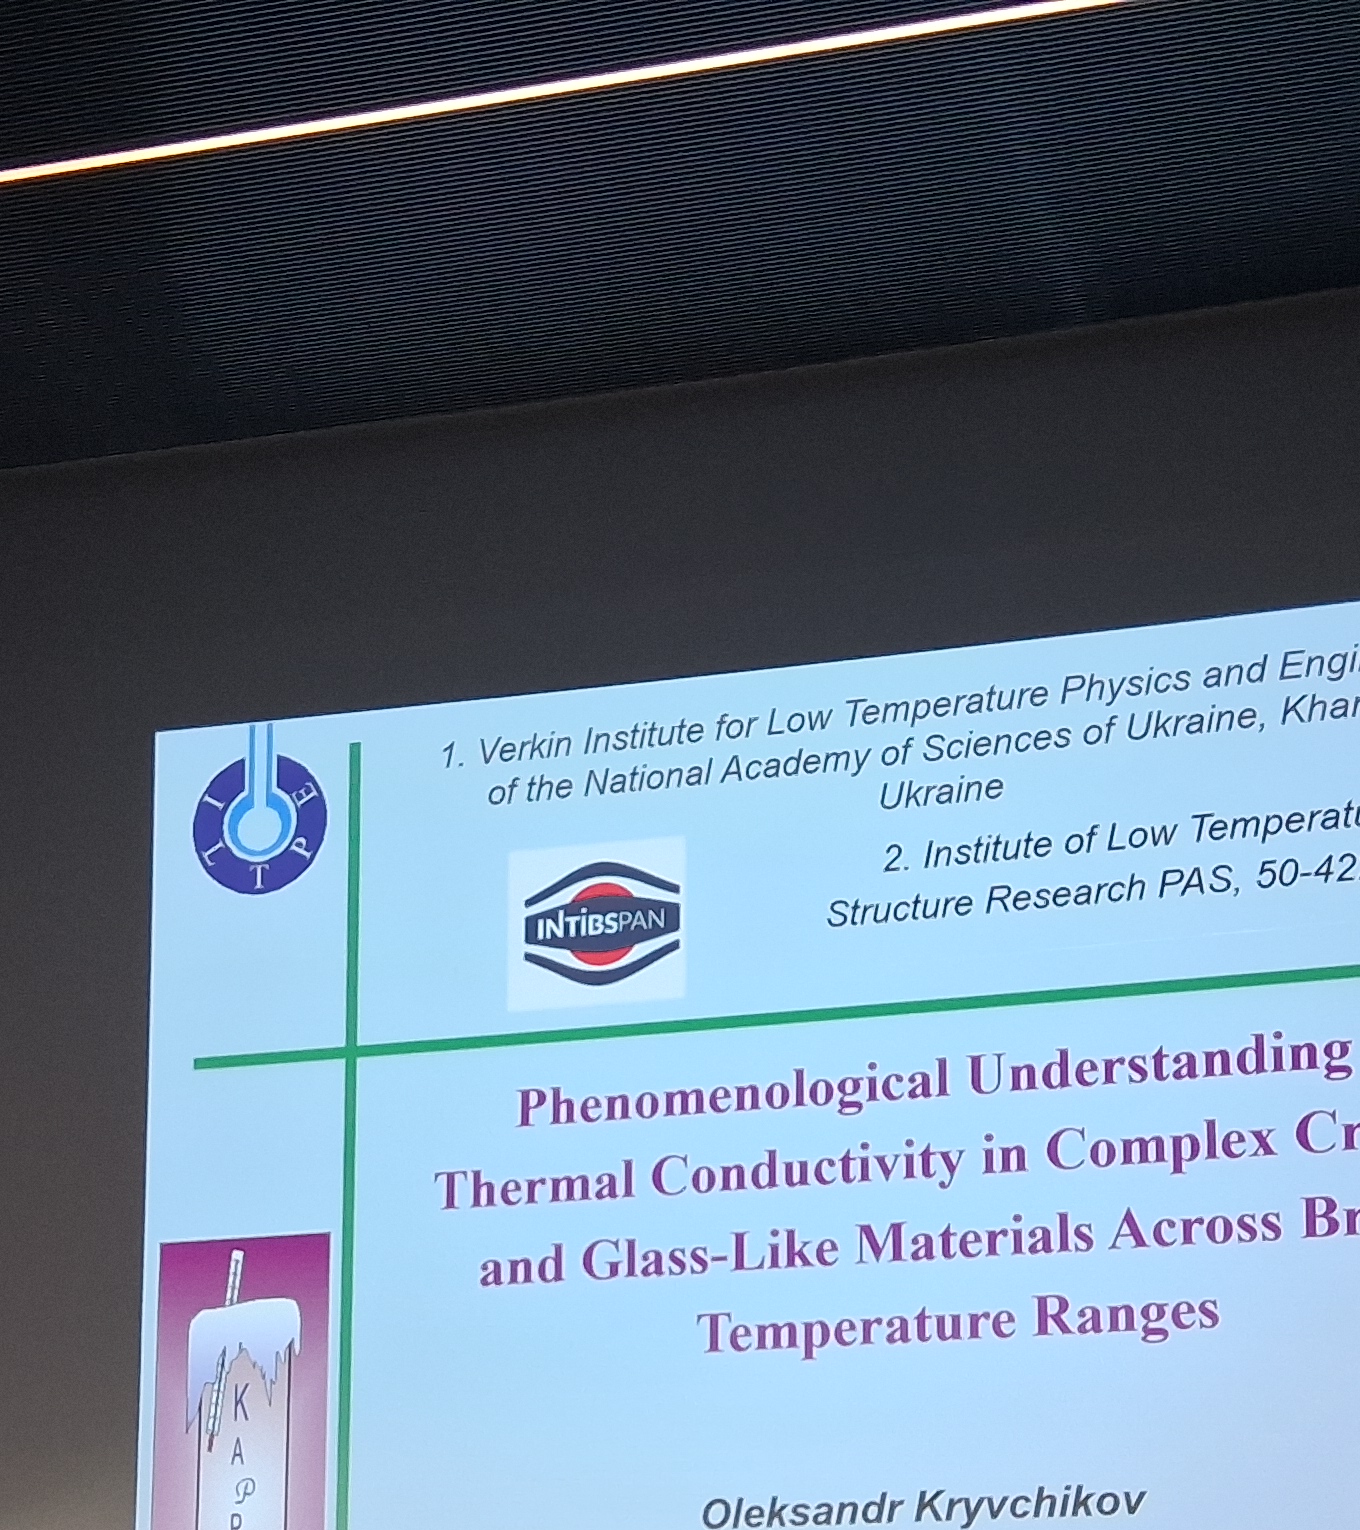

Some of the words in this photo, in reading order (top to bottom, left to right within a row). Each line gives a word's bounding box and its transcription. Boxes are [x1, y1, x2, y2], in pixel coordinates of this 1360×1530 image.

[442, 740, 465, 770] 1.
[479, 730, 573, 766] Verkin
[583, 717, 705, 756] Institute
[714, 712, 761, 742] for
[766, 707, 834, 737] Low
[844, 683, 1053, 730] Temperature
[1060, 665, 1192, 707] Physics
[1202, 652, 1269, 689] and
[487, 776, 522, 806] of
[524, 773, 574, 803] the
[582, 756, 714, 798] National
[718, 747, 873, 785] Academy
[880, 735, 916, 767] of
[921, 727, 1073, 763] Sciences
[1082, 714, 1120, 746] of
[1126, 703, 1266, 741] Ukraine,
[879, 774, 1005, 811] Ukraine
[882, 843, 910, 874] 2.
[922, 829, 1053, 870] Institute
[1064, 823, 1101, 855] of
[1106, 821, 1180, 852] Low
[825, 892, 974, 928] Structure
[984, 871, 1147, 915] Research
[1157, 864, 1240, 900] PAS,
[515, 1057, 951, 1126] Phenomenological
[966, 1031, 1353, 1093] Understanding
[434, 1159, 635, 1209] Thermal
[651, 1140, 964, 1194] Conductivity
[982, 1133, 1029, 1174] in
[1047, 1119, 1278, 1174] Complex
[480, 1243, 565, 1287] and
[582, 1228, 839, 1279] Glass-Like
[855, 1212, 1094, 1263] Materials
[1108, 1207, 1282, 1249] Across
[697, 1306, 1016, 1360] Temperature
[1031, 1294, 1219, 1342] Ranges
[701, 1490, 906, 1530] Oleksandr
[913, 1483, 1149, 1530] Kryvchikov
